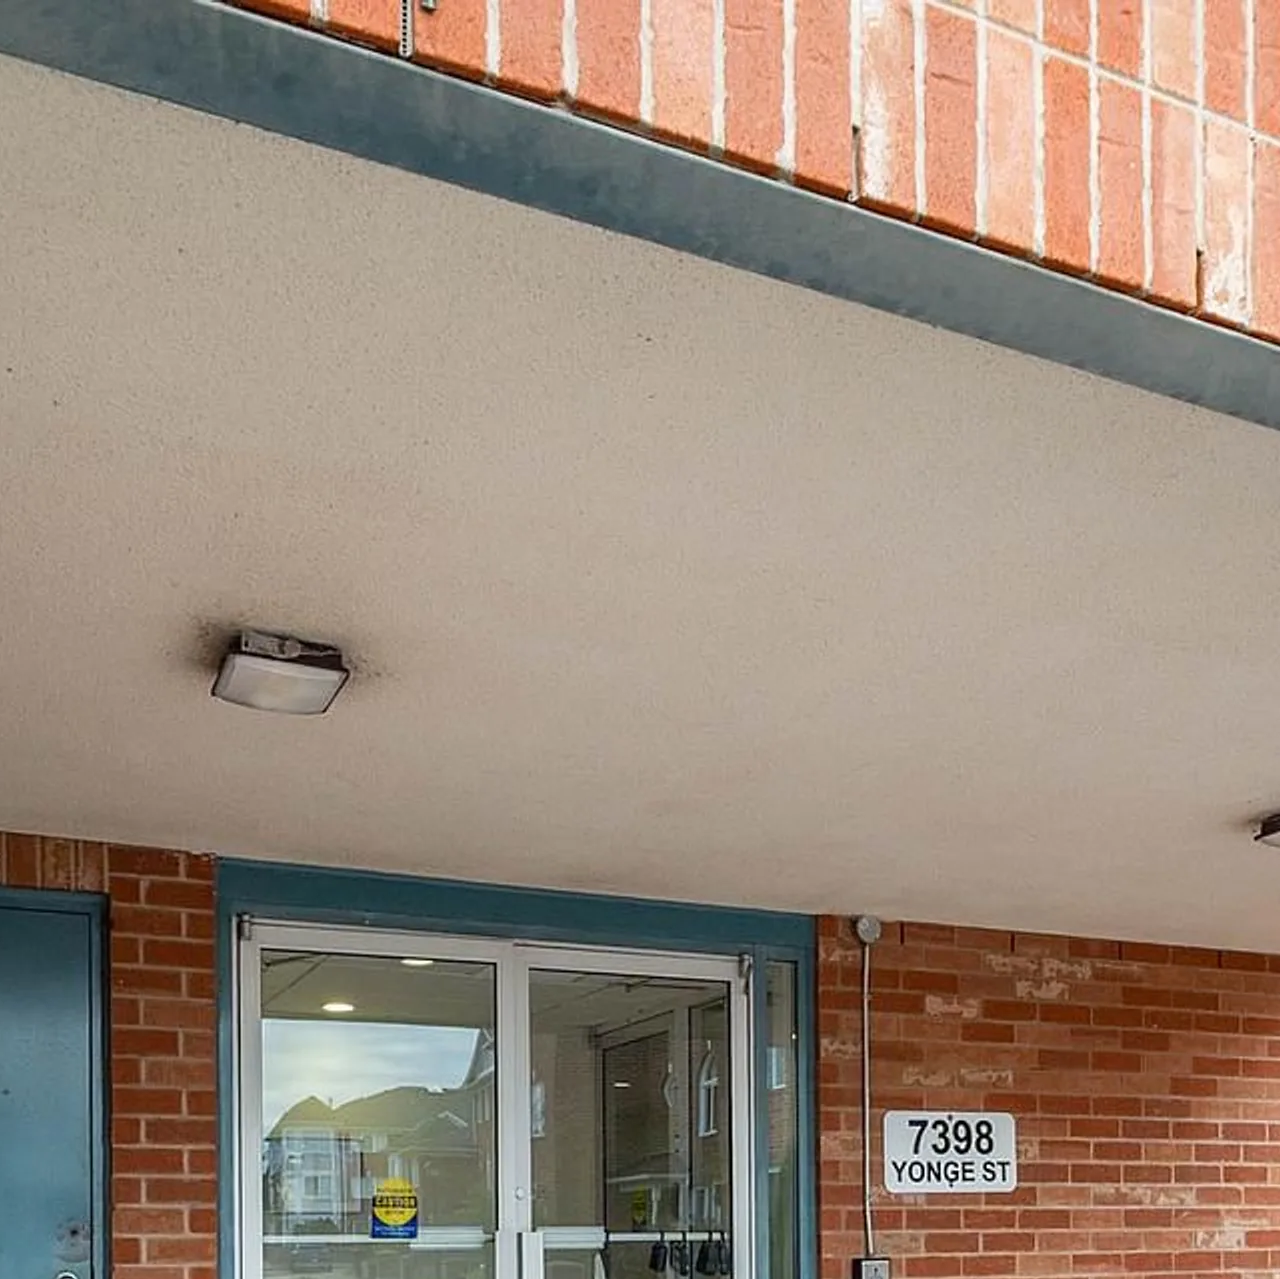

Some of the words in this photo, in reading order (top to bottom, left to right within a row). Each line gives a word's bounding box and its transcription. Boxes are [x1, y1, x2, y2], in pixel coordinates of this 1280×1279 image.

[908, 1120, 994, 1155] 7398
[892, 1161, 975, 1183] YONGE
[982, 1161, 1010, 1183] ST
